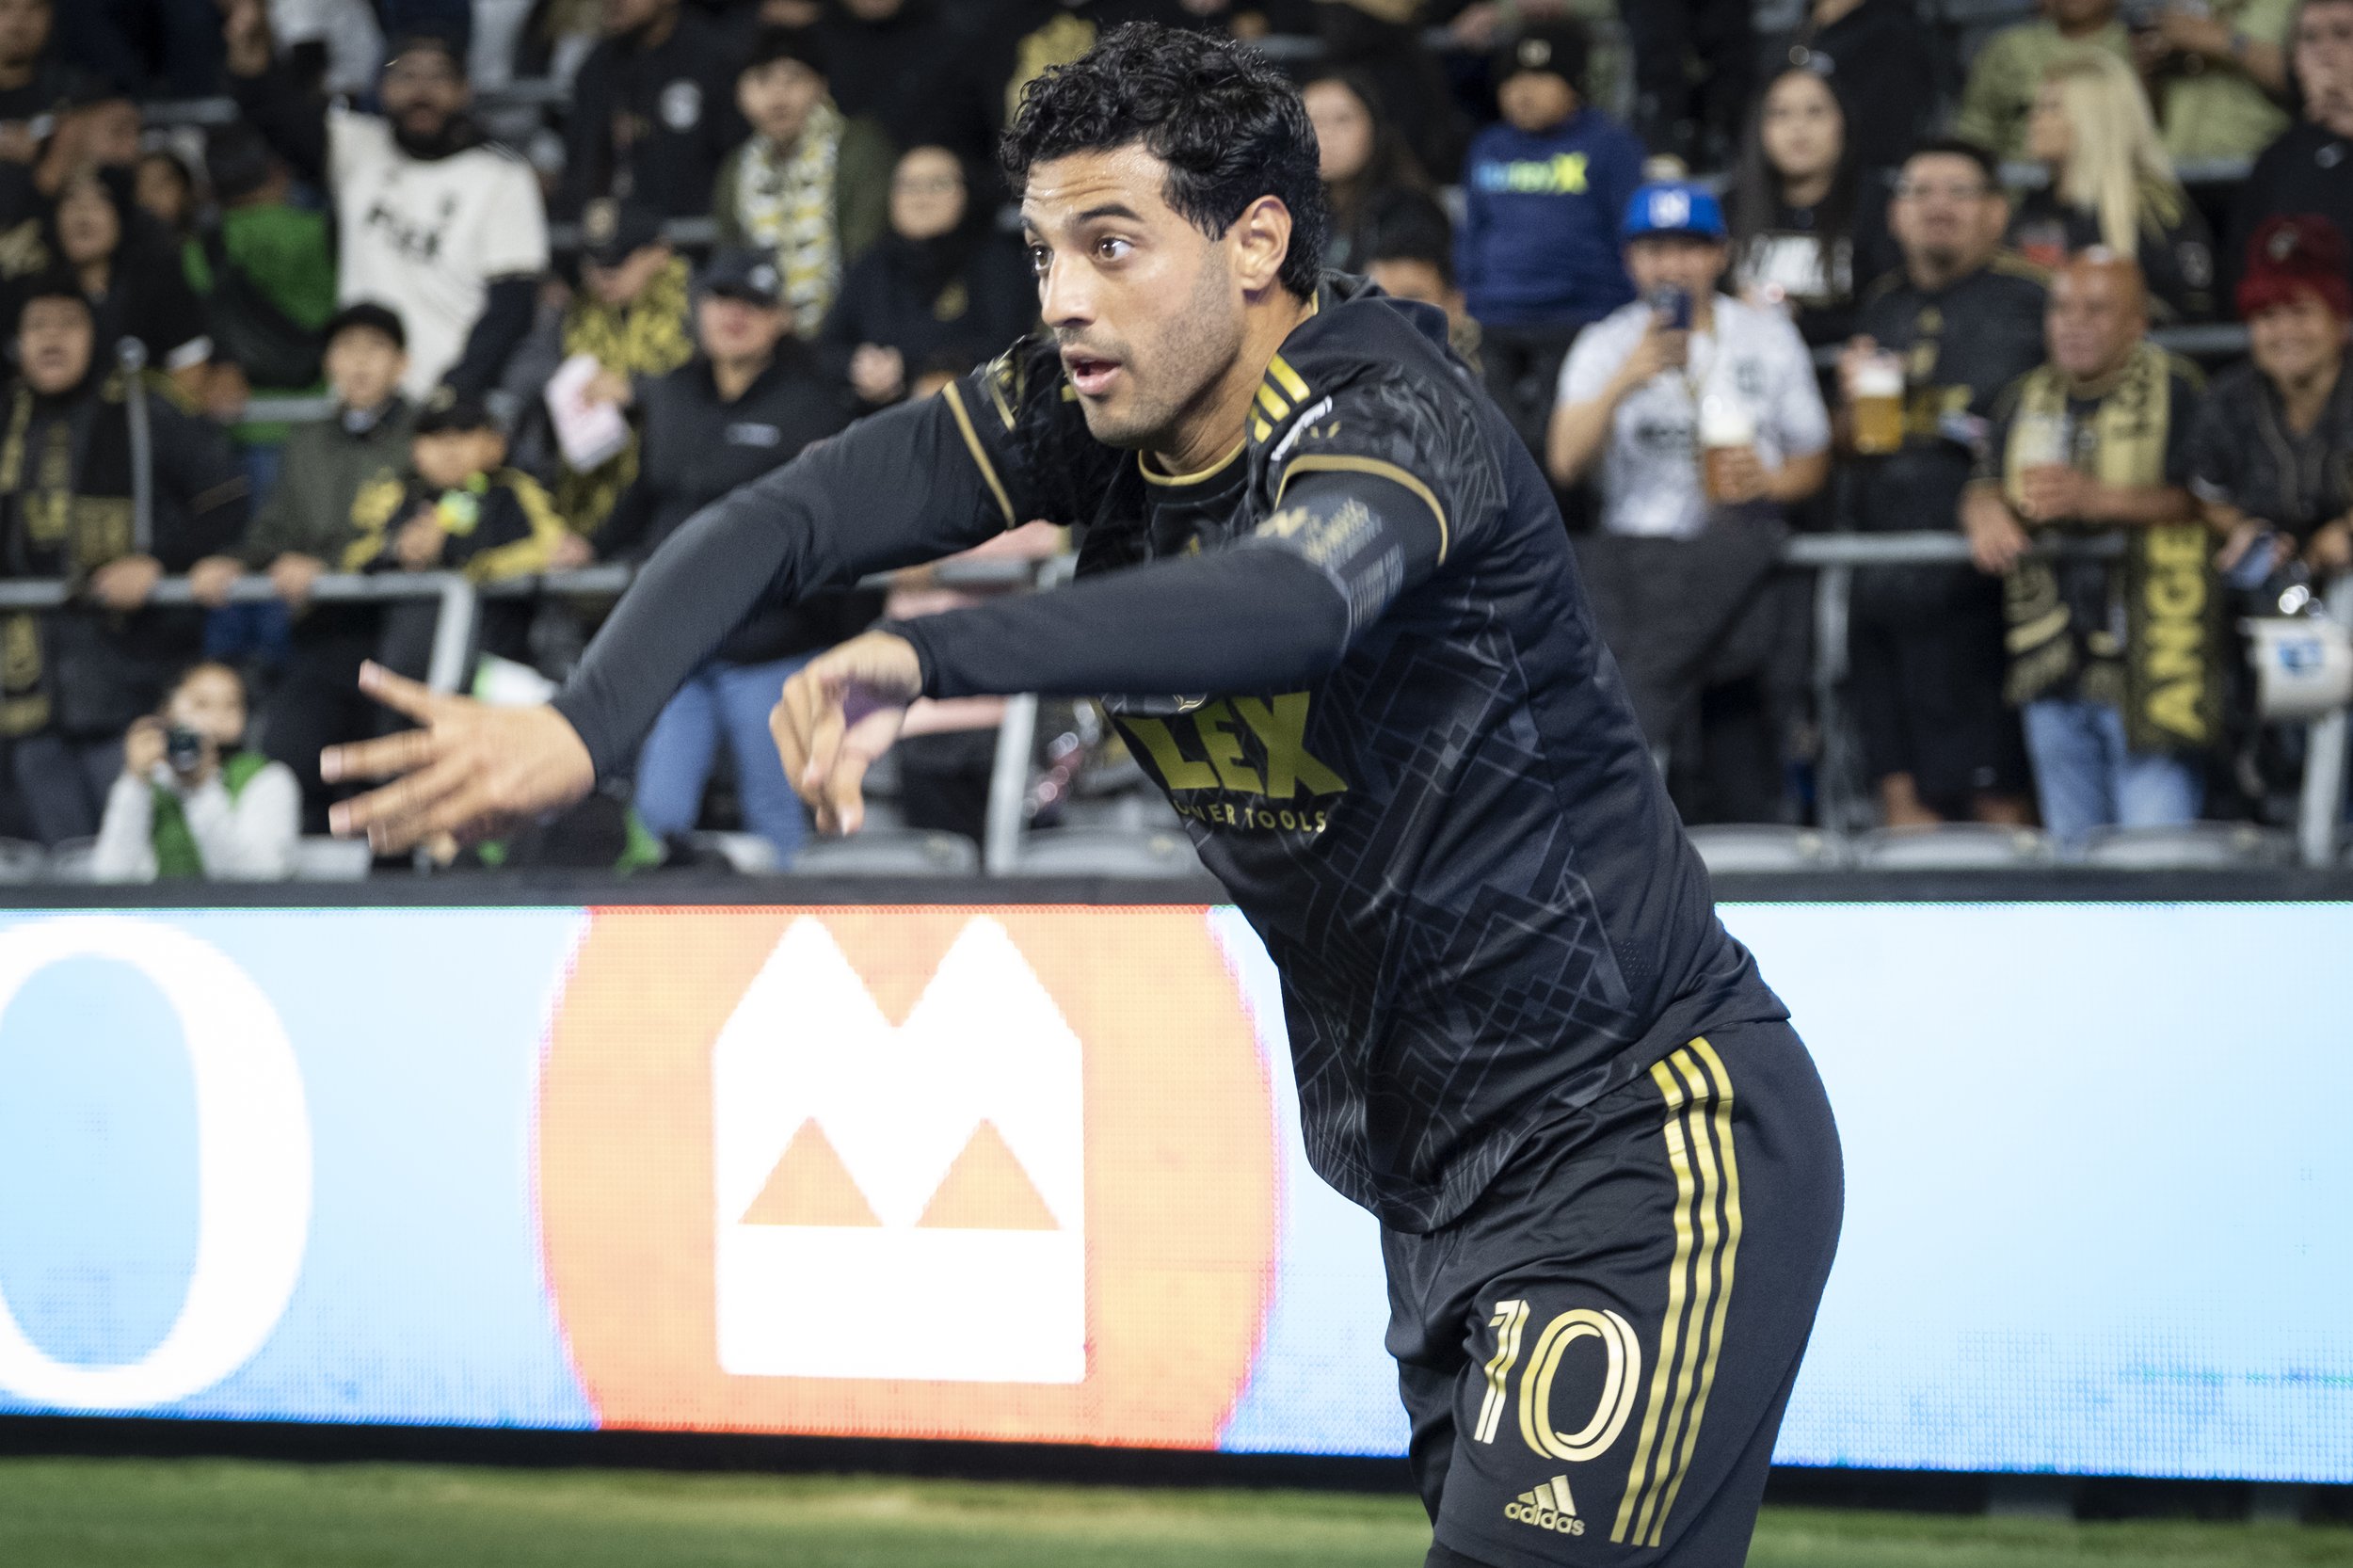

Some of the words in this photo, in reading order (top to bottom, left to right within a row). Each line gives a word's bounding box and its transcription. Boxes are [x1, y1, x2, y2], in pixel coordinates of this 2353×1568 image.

[1120, 691, 1350, 799] LEX
[1244, 806, 1327, 833] TOOLS
[1473, 1299, 1642, 1463] 10
[1504, 1501, 1586, 1537] adidas
